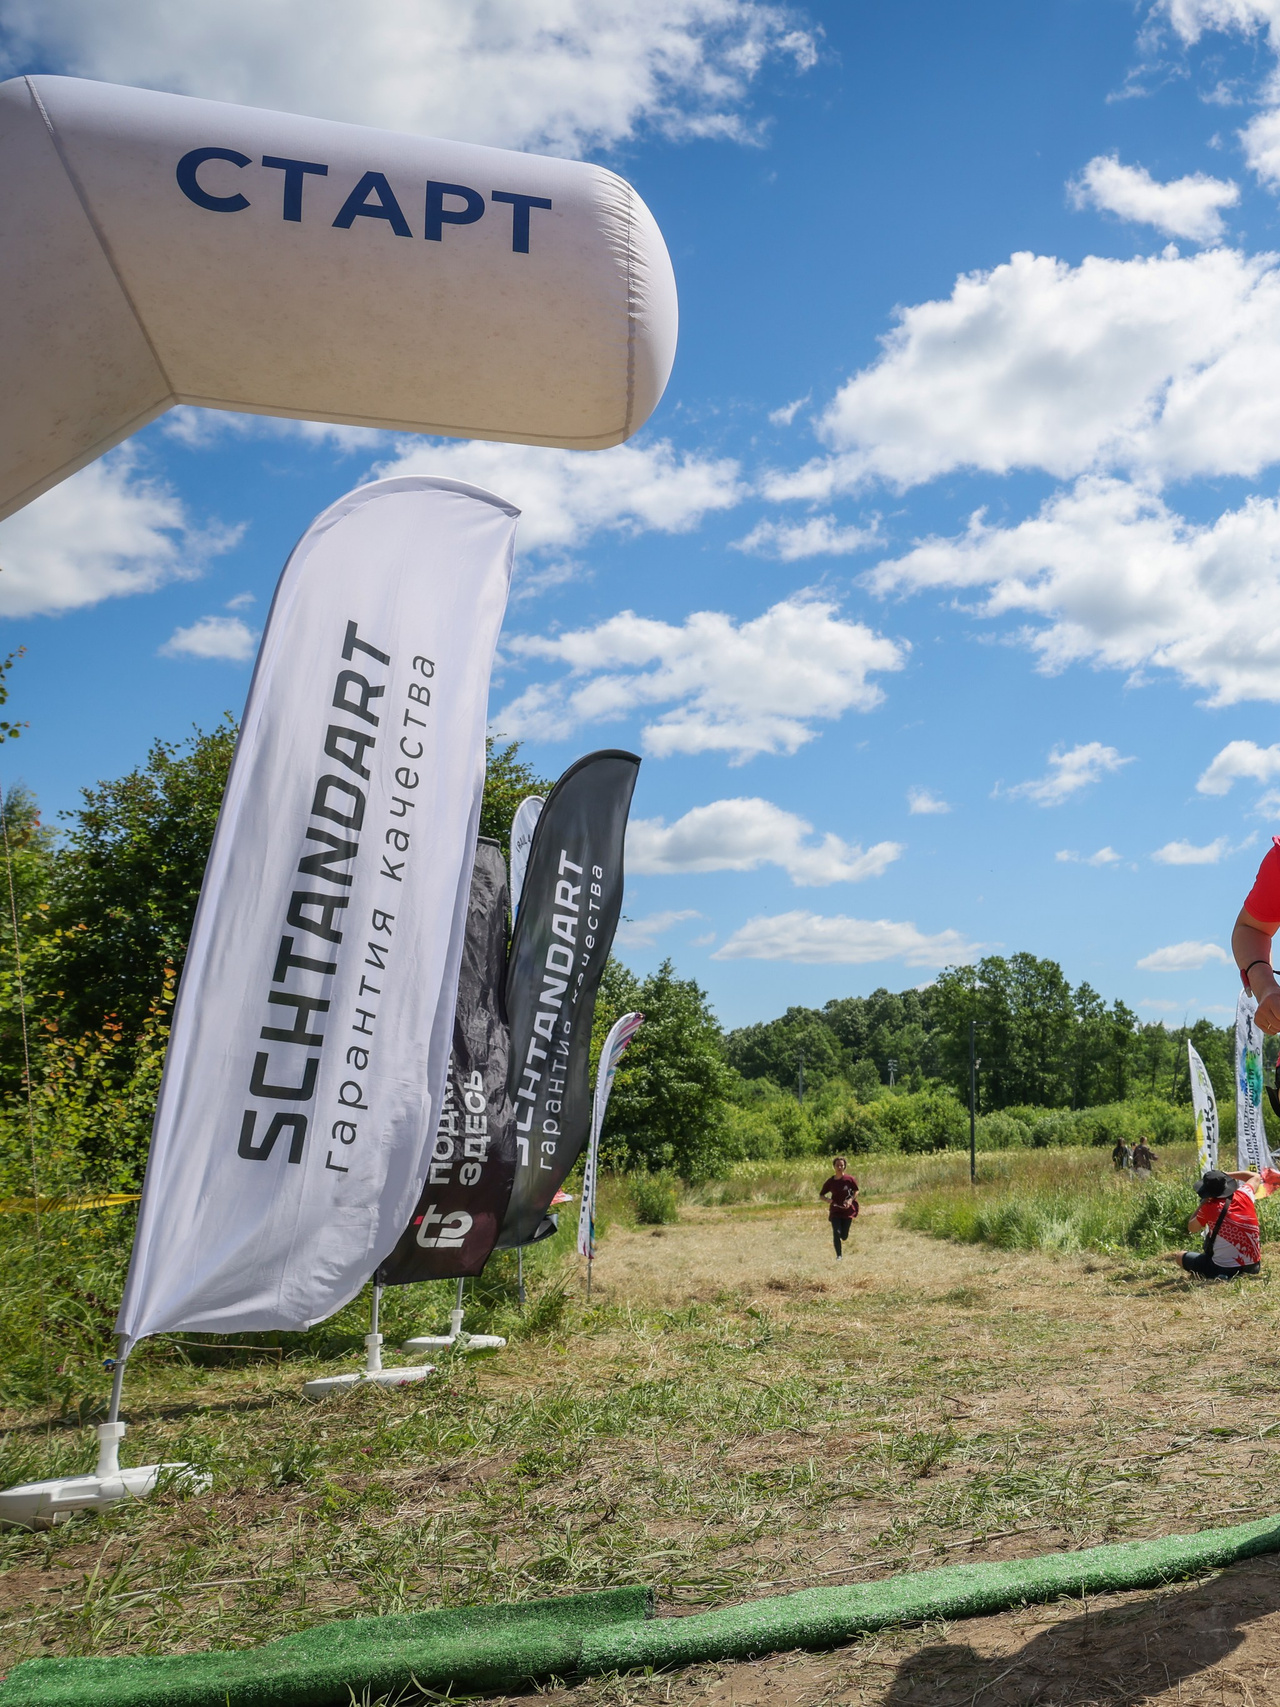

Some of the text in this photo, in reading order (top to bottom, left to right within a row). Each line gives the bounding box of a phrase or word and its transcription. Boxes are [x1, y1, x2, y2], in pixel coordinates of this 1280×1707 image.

[176, 147, 552, 254] СТАРТ
[237, 619, 391, 1164] SCHTANDART
[325, 655, 435, 1172] гарантия качества
[459, 1070, 491, 1186] ЗДЕСЬ
